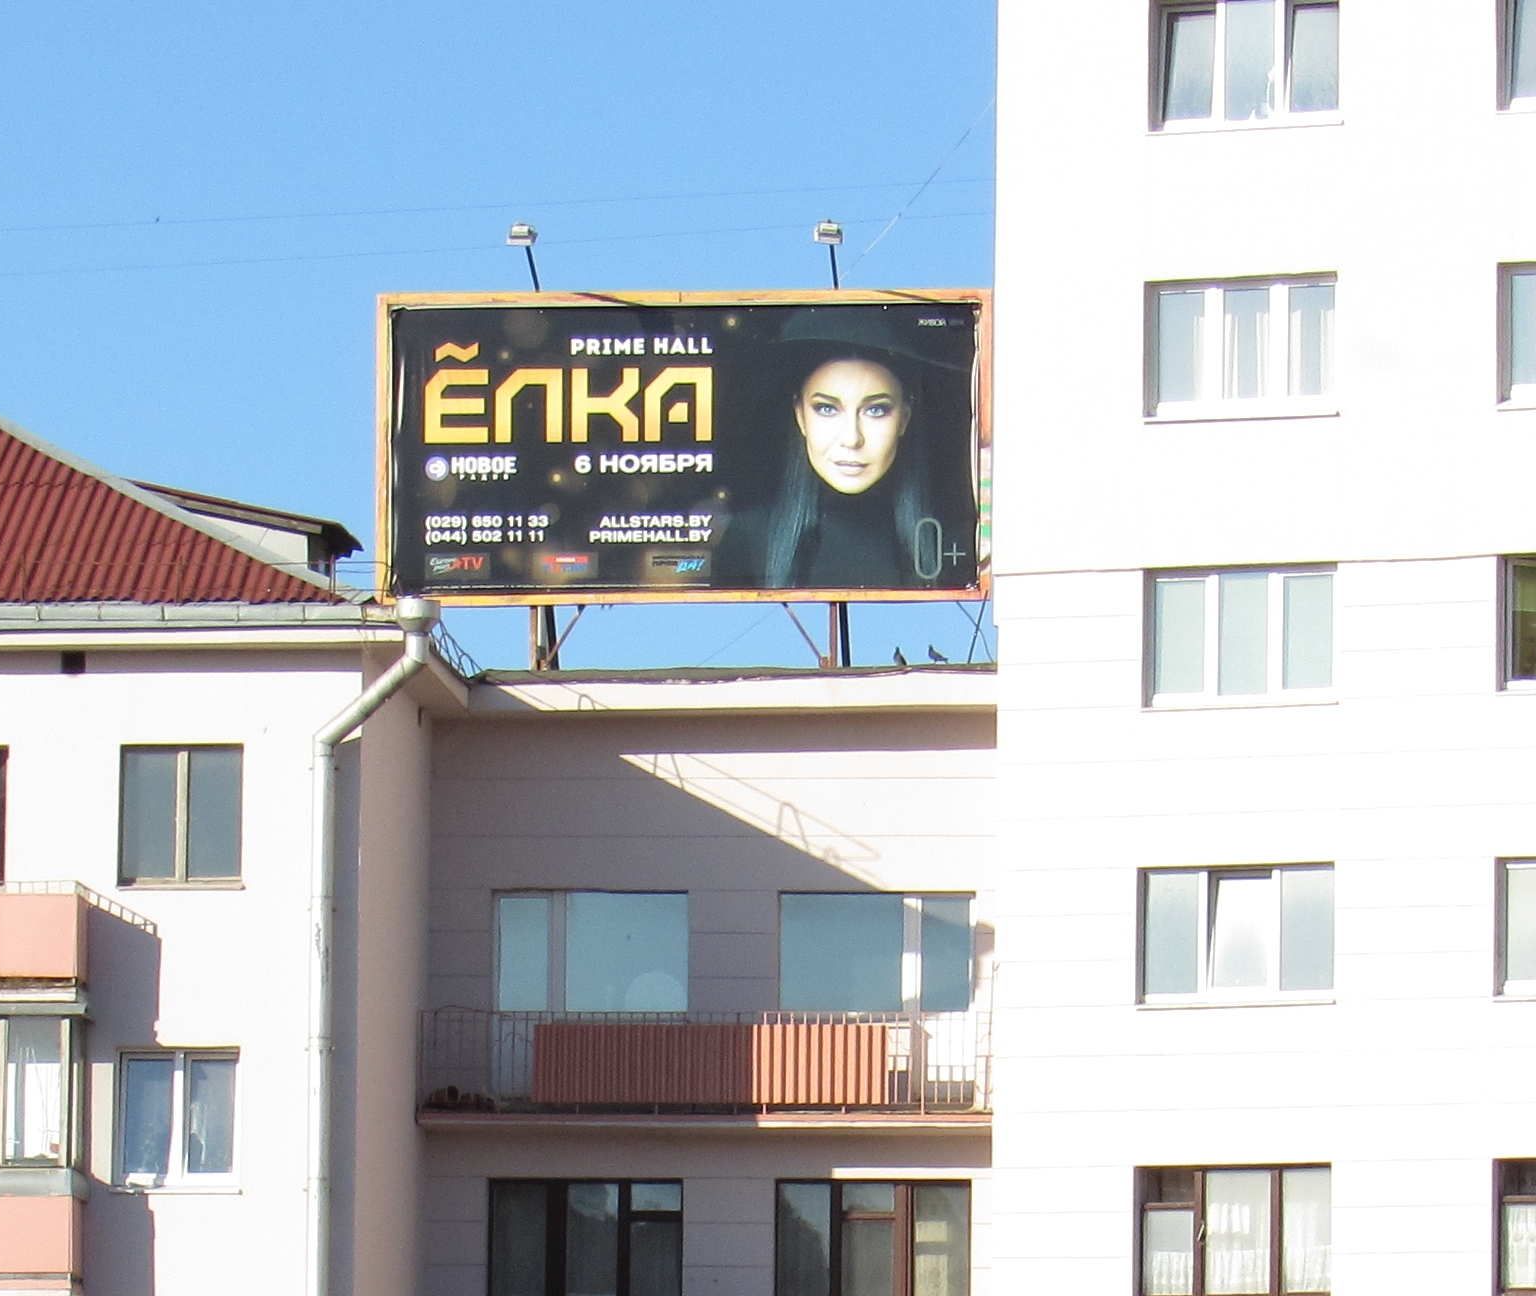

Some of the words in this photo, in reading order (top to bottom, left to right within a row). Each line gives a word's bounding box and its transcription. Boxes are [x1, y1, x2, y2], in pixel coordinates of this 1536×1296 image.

[570, 337, 645, 356] PRIME
[653, 336, 714, 355] HALL
[423, 341, 714, 444] ЁЛКА
[450, 455, 518, 475] НОВОЕ
[574, 453, 593, 474] 6
[600, 452, 714, 474] НОЯБРЯ
[424, 514, 469, 530] (029)
[472, 514, 504, 529] 650
[507, 514, 524, 529] 11
[527, 514, 550, 529] 33
[599, 514, 713, 529] ALLSTARS.BY
[424, 529, 469, 545] (044)
[472, 529, 503, 543] 502
[507, 529, 524, 543] 11
[527, 529, 545, 543] 11
[588, 529, 713, 544] PRIMEHALL.BY
[462, 556, 485, 571] TV
